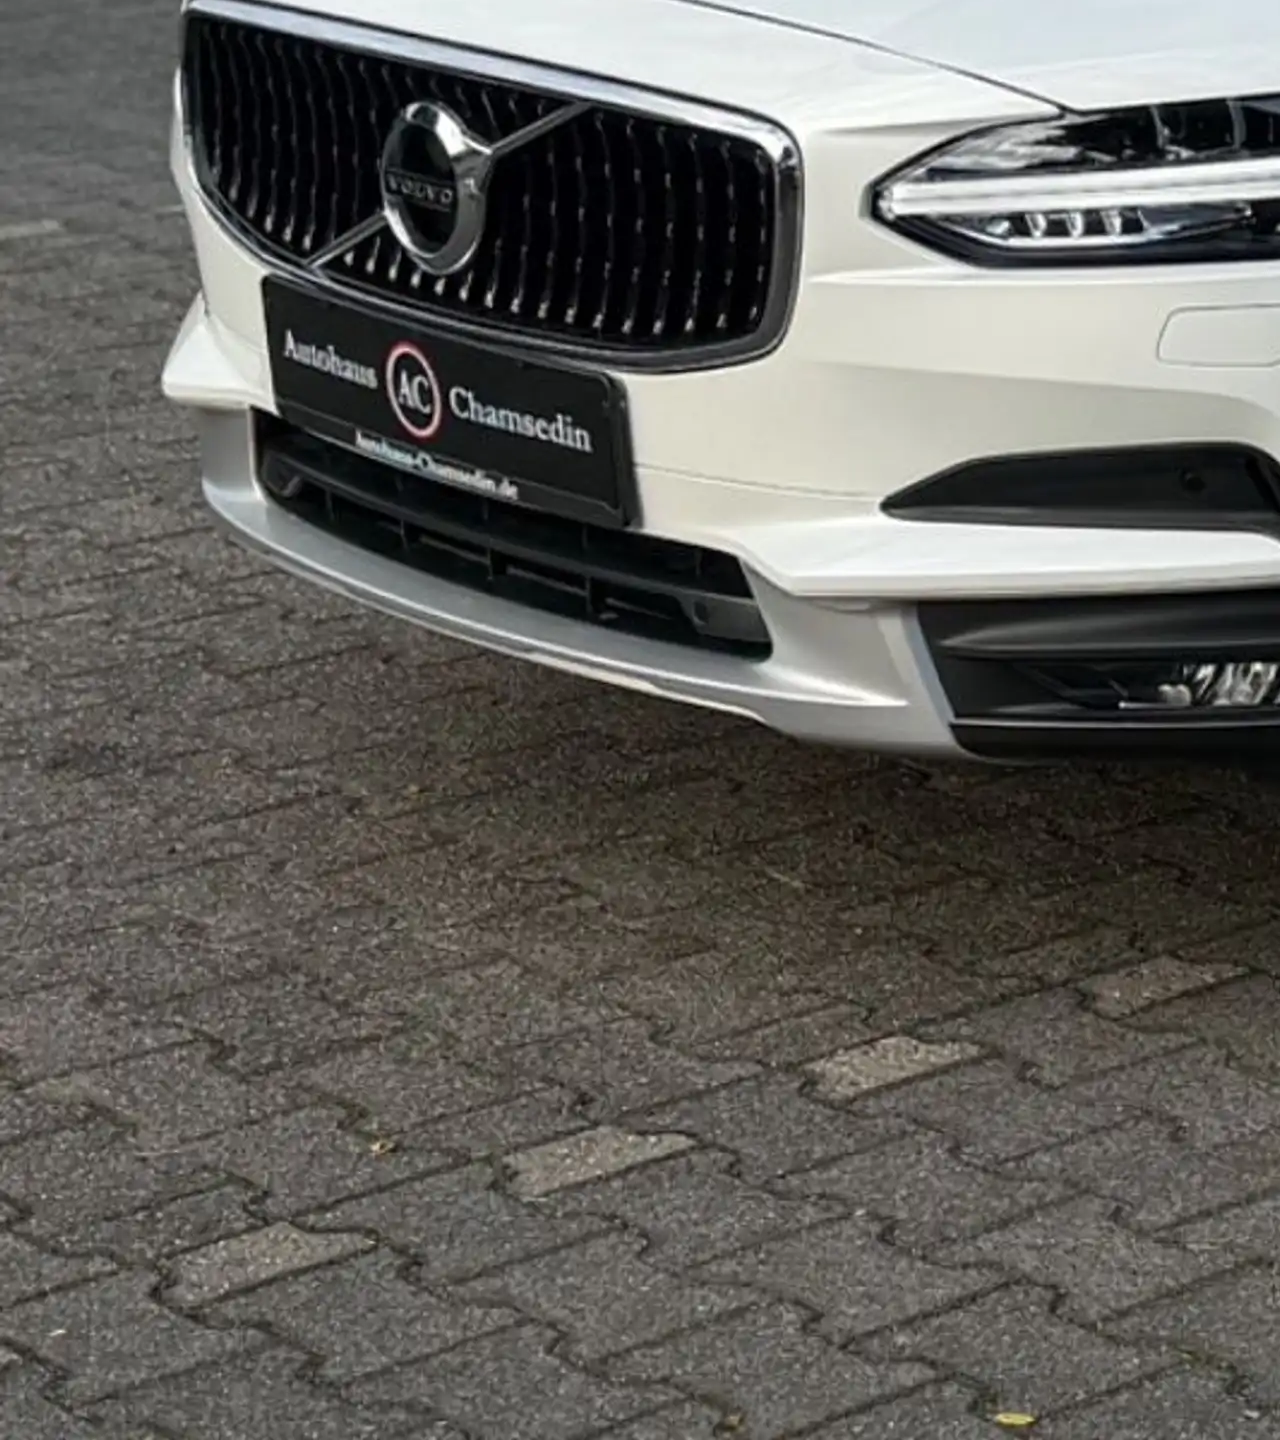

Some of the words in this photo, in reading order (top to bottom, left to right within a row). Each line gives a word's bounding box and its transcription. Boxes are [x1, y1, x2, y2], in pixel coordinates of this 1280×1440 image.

[386, 172, 454, 206] VOLVO
[284, 328, 378, 390] Autohaus
[398, 369, 431, 415] AC
[449, 386, 593, 453] Chamsedin
